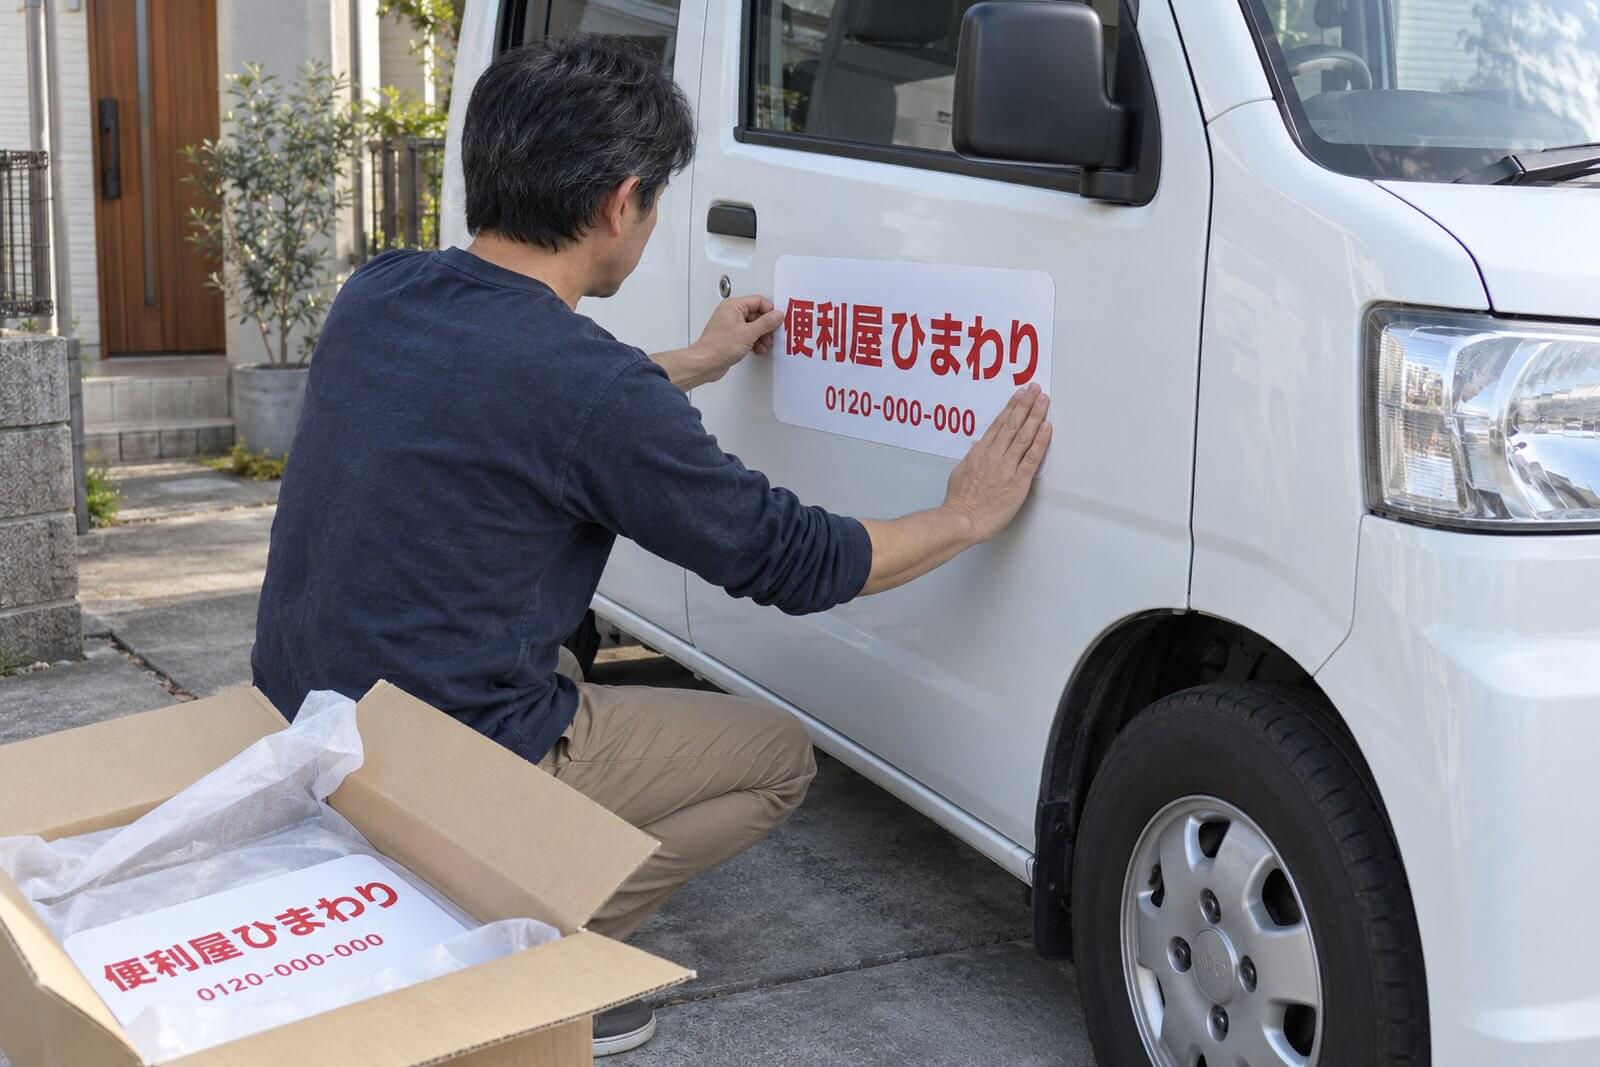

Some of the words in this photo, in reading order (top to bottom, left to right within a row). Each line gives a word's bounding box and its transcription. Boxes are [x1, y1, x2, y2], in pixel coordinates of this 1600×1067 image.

[784, 298, 1039, 386] 便利屋ひまわり
[825, 385, 976, 437] 0120-000-000
[103, 881, 399, 992] 便利屋ひまわり
[196, 933, 384, 1002] 0120-000-000
